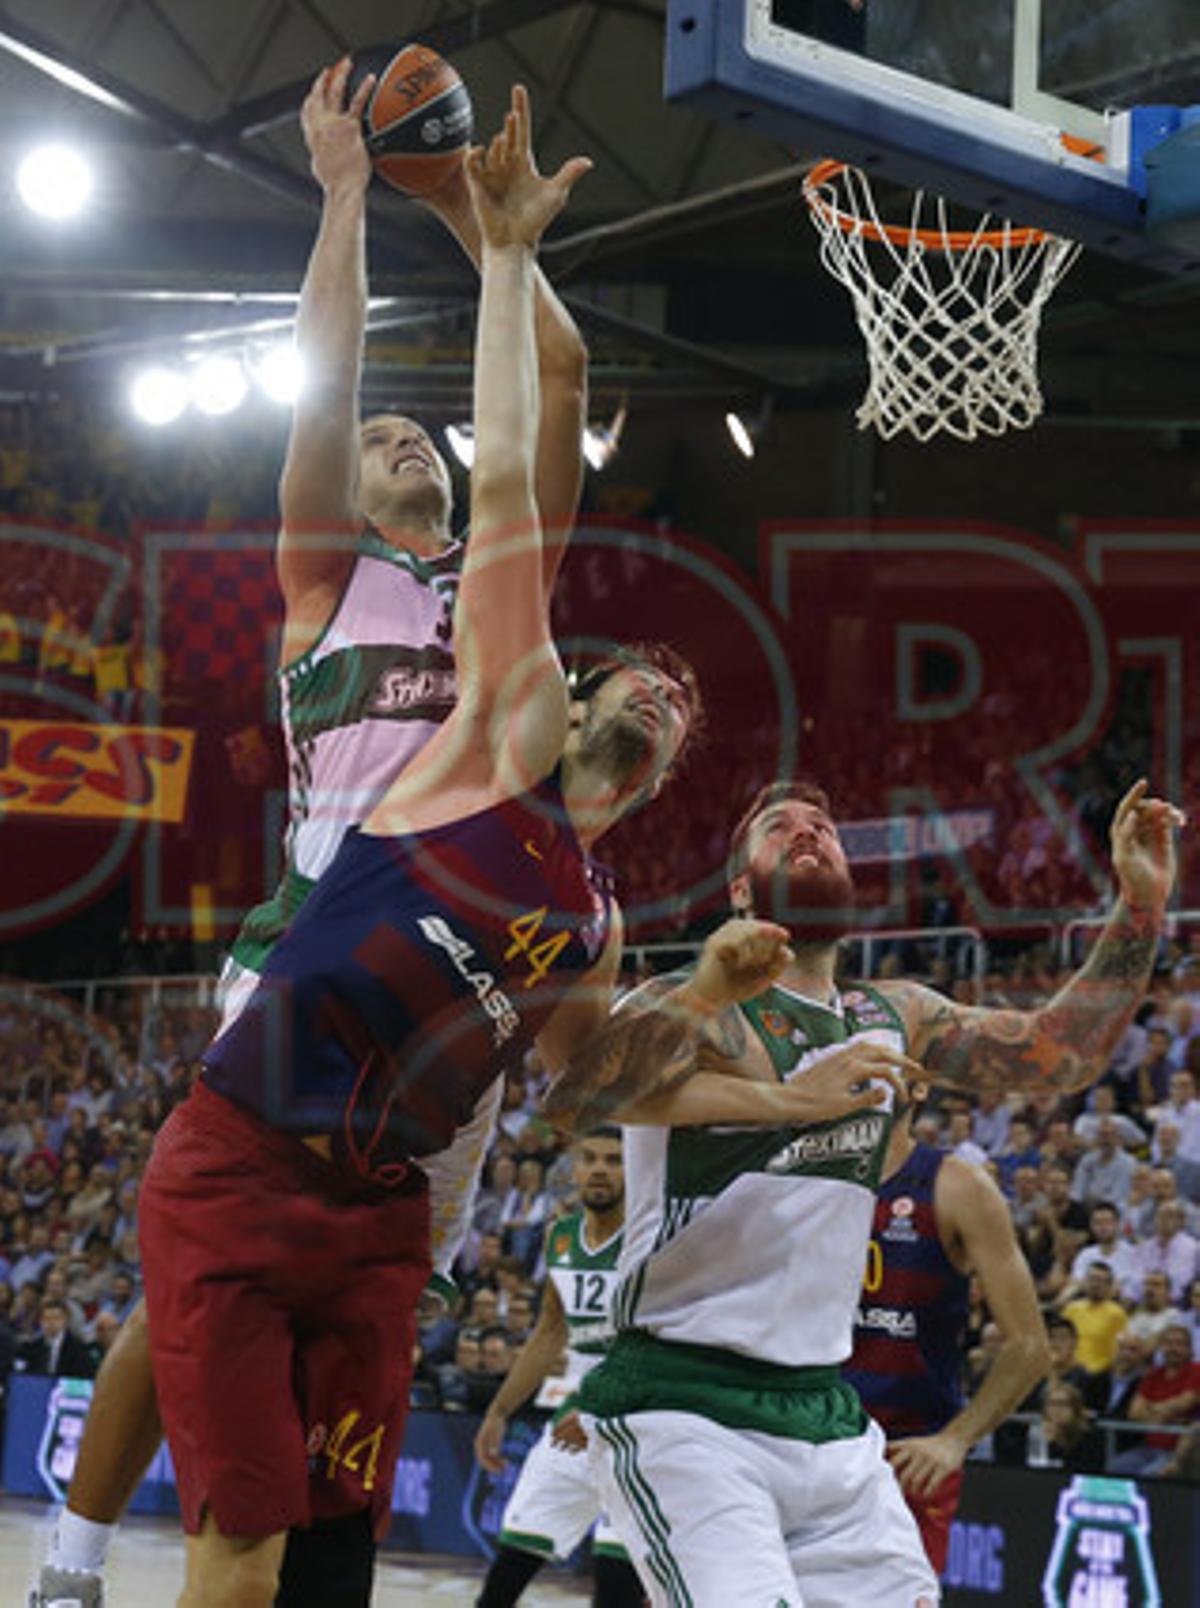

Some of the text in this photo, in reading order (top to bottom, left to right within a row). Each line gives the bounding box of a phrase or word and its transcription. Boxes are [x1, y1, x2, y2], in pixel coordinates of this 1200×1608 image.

[503, 905, 573, 990] 44
[573, 1273, 607, 1313] 12
[325, 1409, 386, 1492] 44
